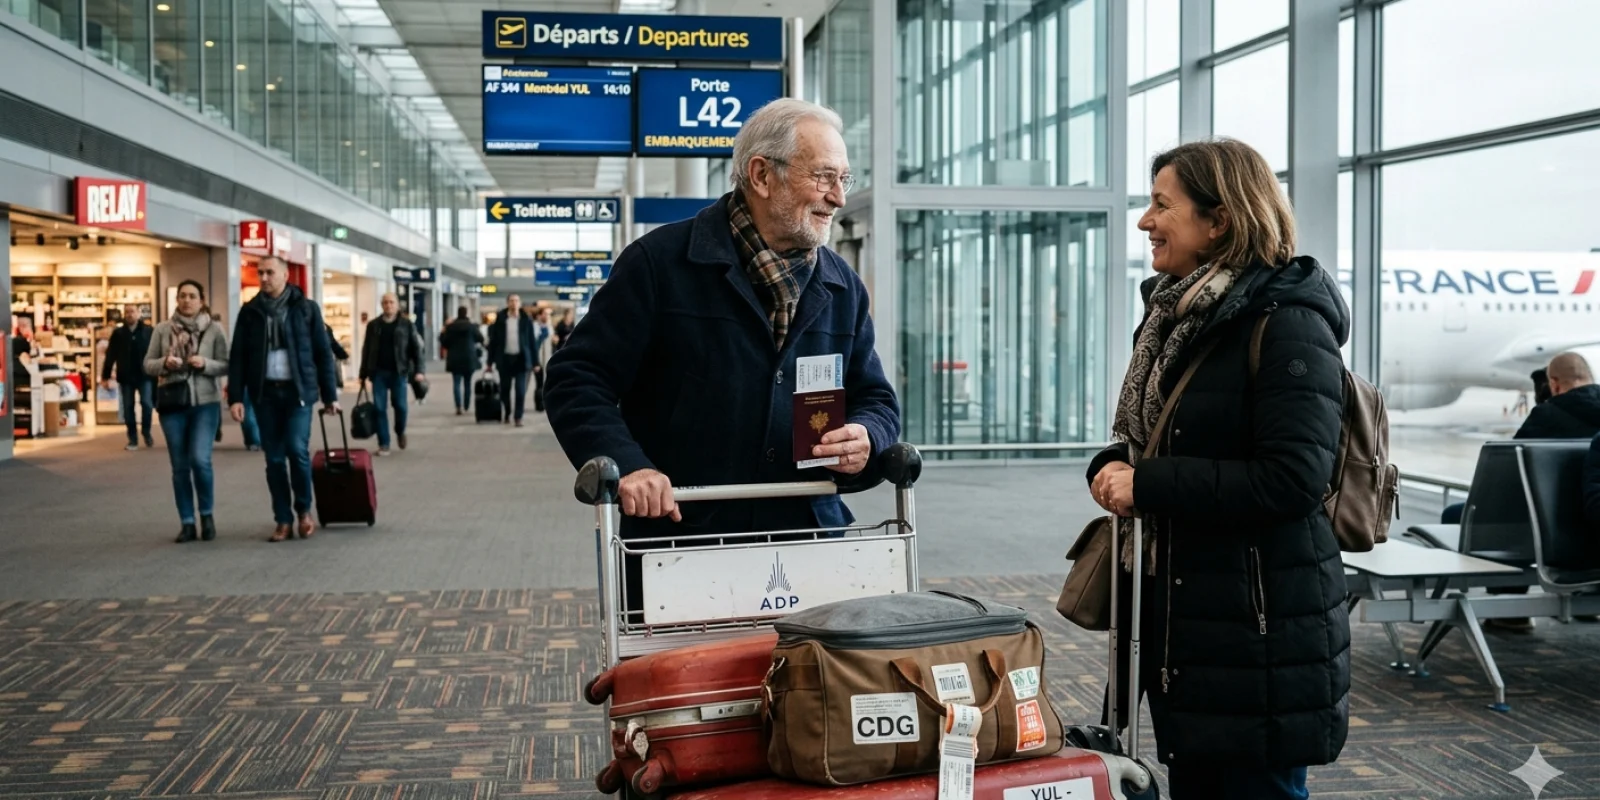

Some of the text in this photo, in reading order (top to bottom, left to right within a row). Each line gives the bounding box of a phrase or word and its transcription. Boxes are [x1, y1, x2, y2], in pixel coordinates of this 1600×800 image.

[533, 23, 749, 50] Départs / Departures
[485, 82, 499, 93] AF
[603, 84, 631, 95] 14:10
[691, 78, 730, 92] Porte
[679, 96, 743, 128] L42
[644, 135, 735, 149] EMBARQUEMEN
[512, 202, 572, 218] Toilettes
[760, 595, 800, 610] ADP
[857, 715, 914, 737] CDG
[1031, 786, 1062, 800] YUL
